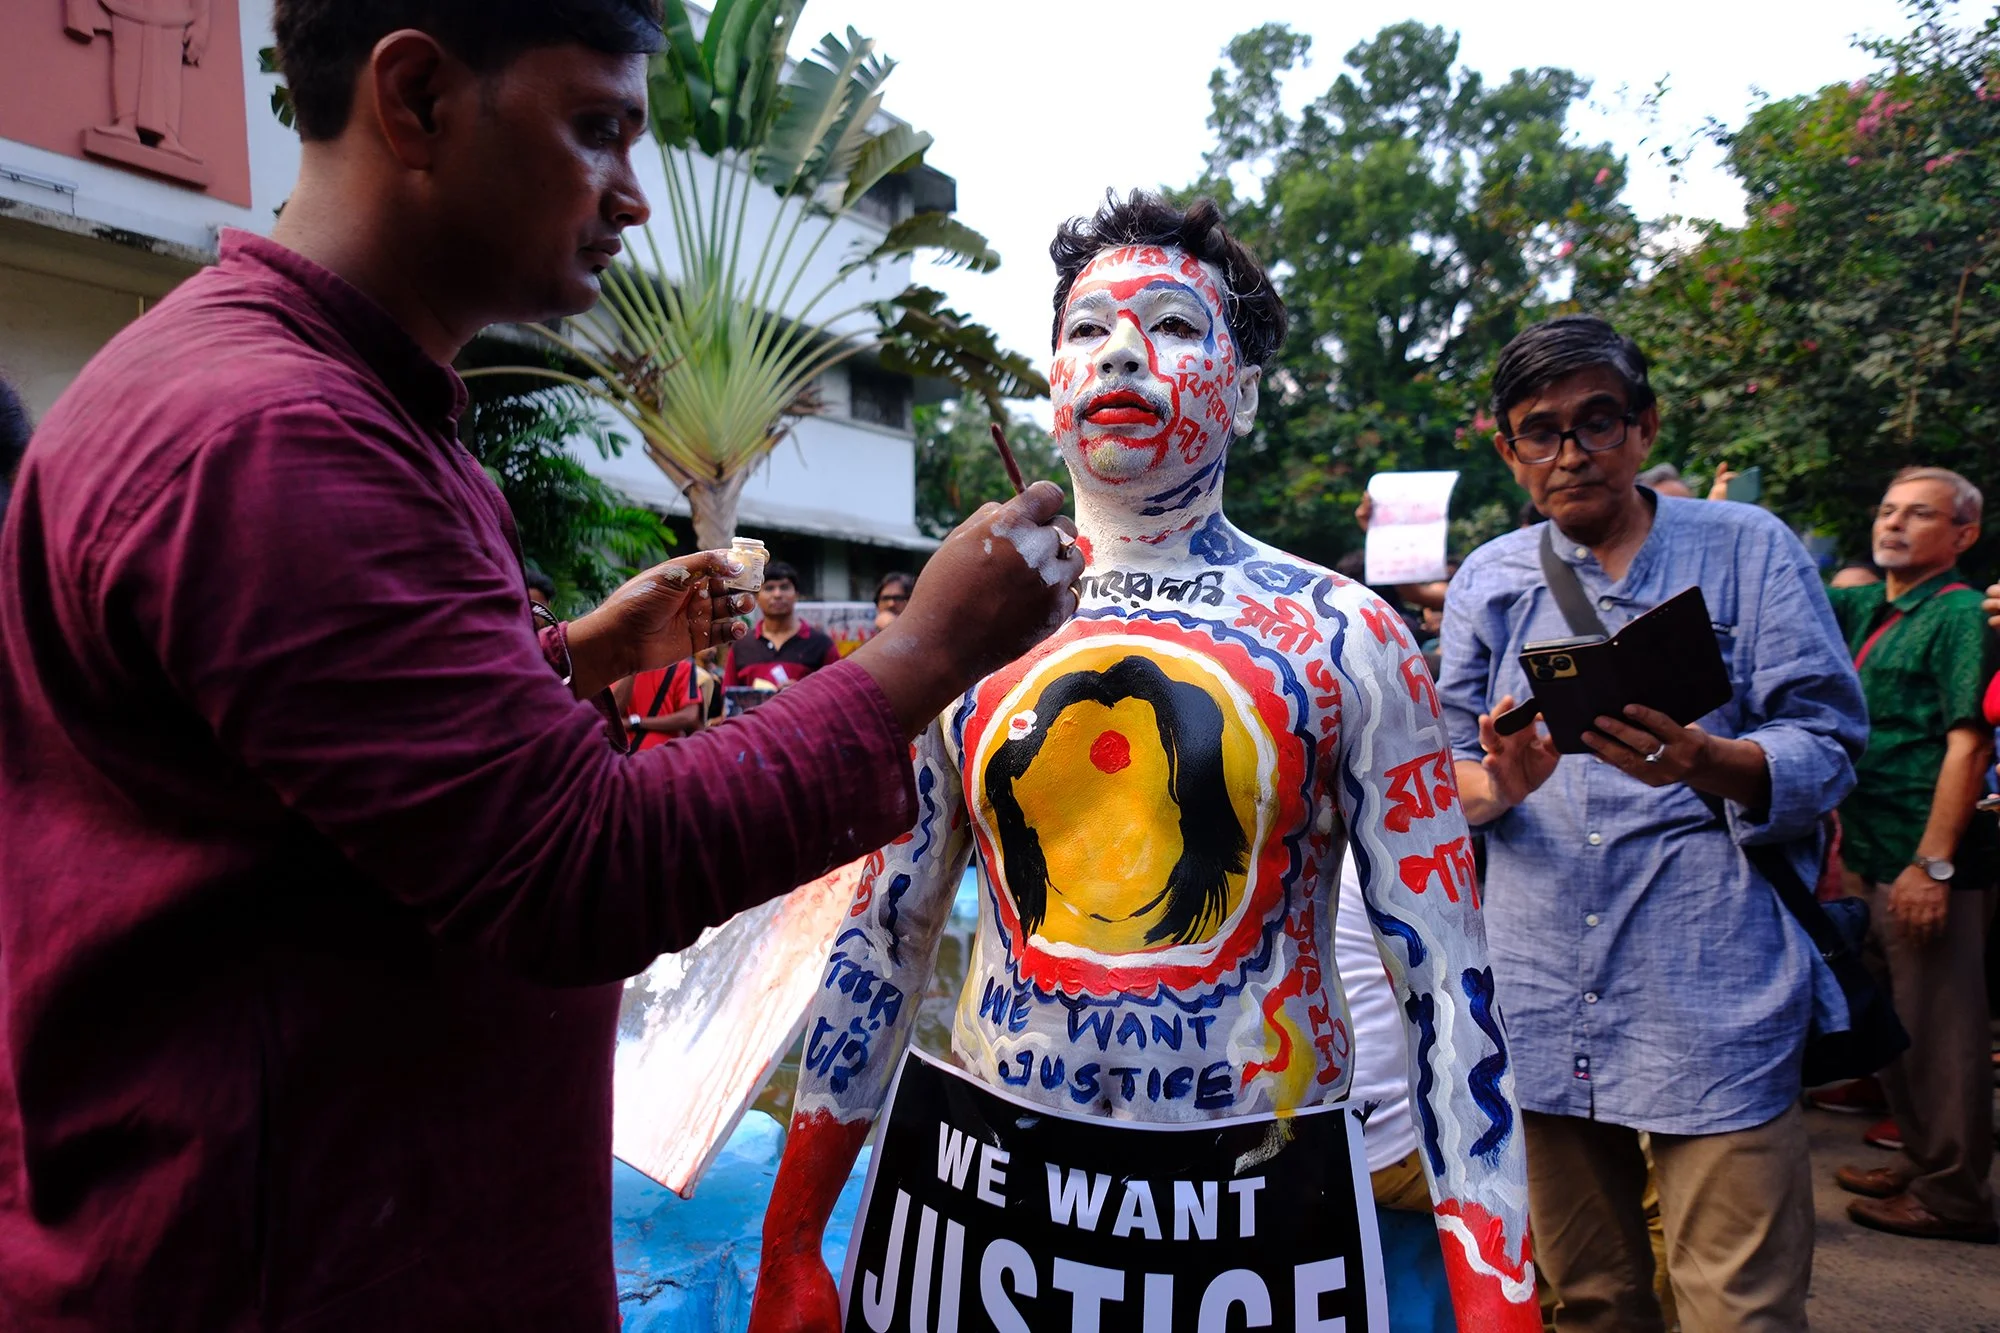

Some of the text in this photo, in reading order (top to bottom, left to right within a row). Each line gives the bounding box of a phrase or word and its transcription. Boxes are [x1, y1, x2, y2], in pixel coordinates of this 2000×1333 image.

[979, 975, 1216, 1052] WE WANT
[998, 1049, 1235, 1110] JUSTICE
[937, 1121, 1266, 1241] WE WANT
